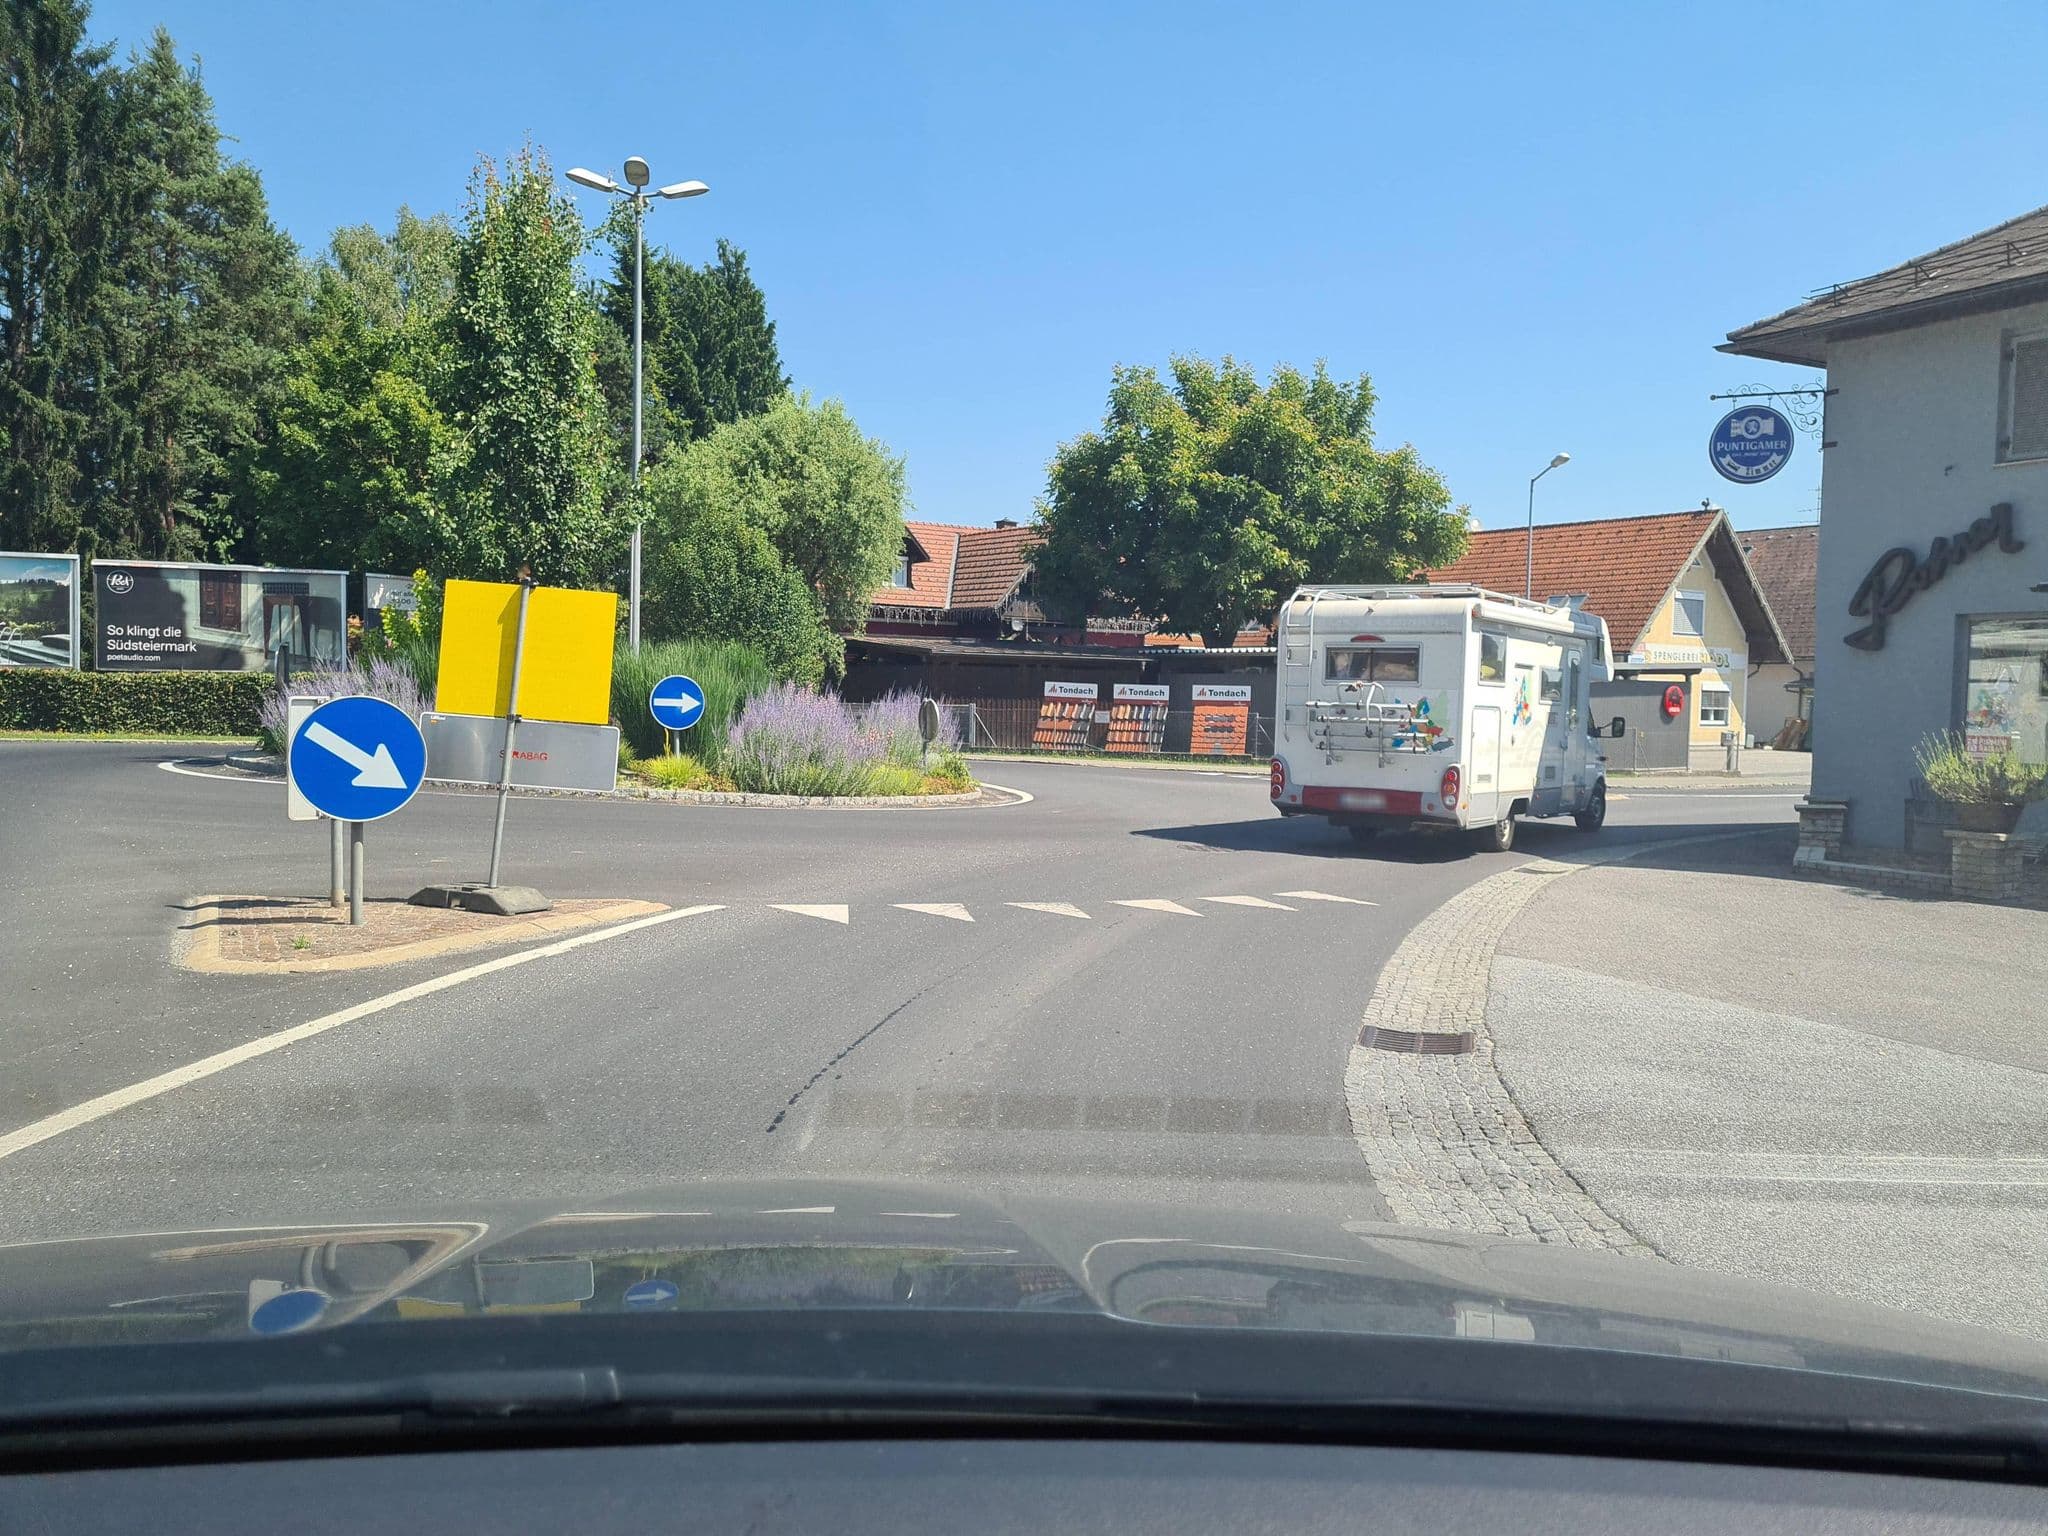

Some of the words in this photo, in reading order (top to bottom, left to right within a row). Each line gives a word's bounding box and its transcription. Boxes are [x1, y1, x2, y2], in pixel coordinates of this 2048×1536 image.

[1716, 441, 1787, 452] PUNTIGAMER
[107, 624, 124, 636] So
[127, 625, 160, 639] klingt
[163, 626, 182, 638] die
[107, 639, 197, 653] Südsteiermark
[107, 654, 161, 662] poetaudio.com
[1653, 651, 1698, 662] SPENGLEREI
[1058, 686, 1094, 696] Tondach
[1128, 688, 1165, 698] Tondach
[1208, 689, 1247, 698] Tondach
[499, 750, 548, 761] SRABAG
